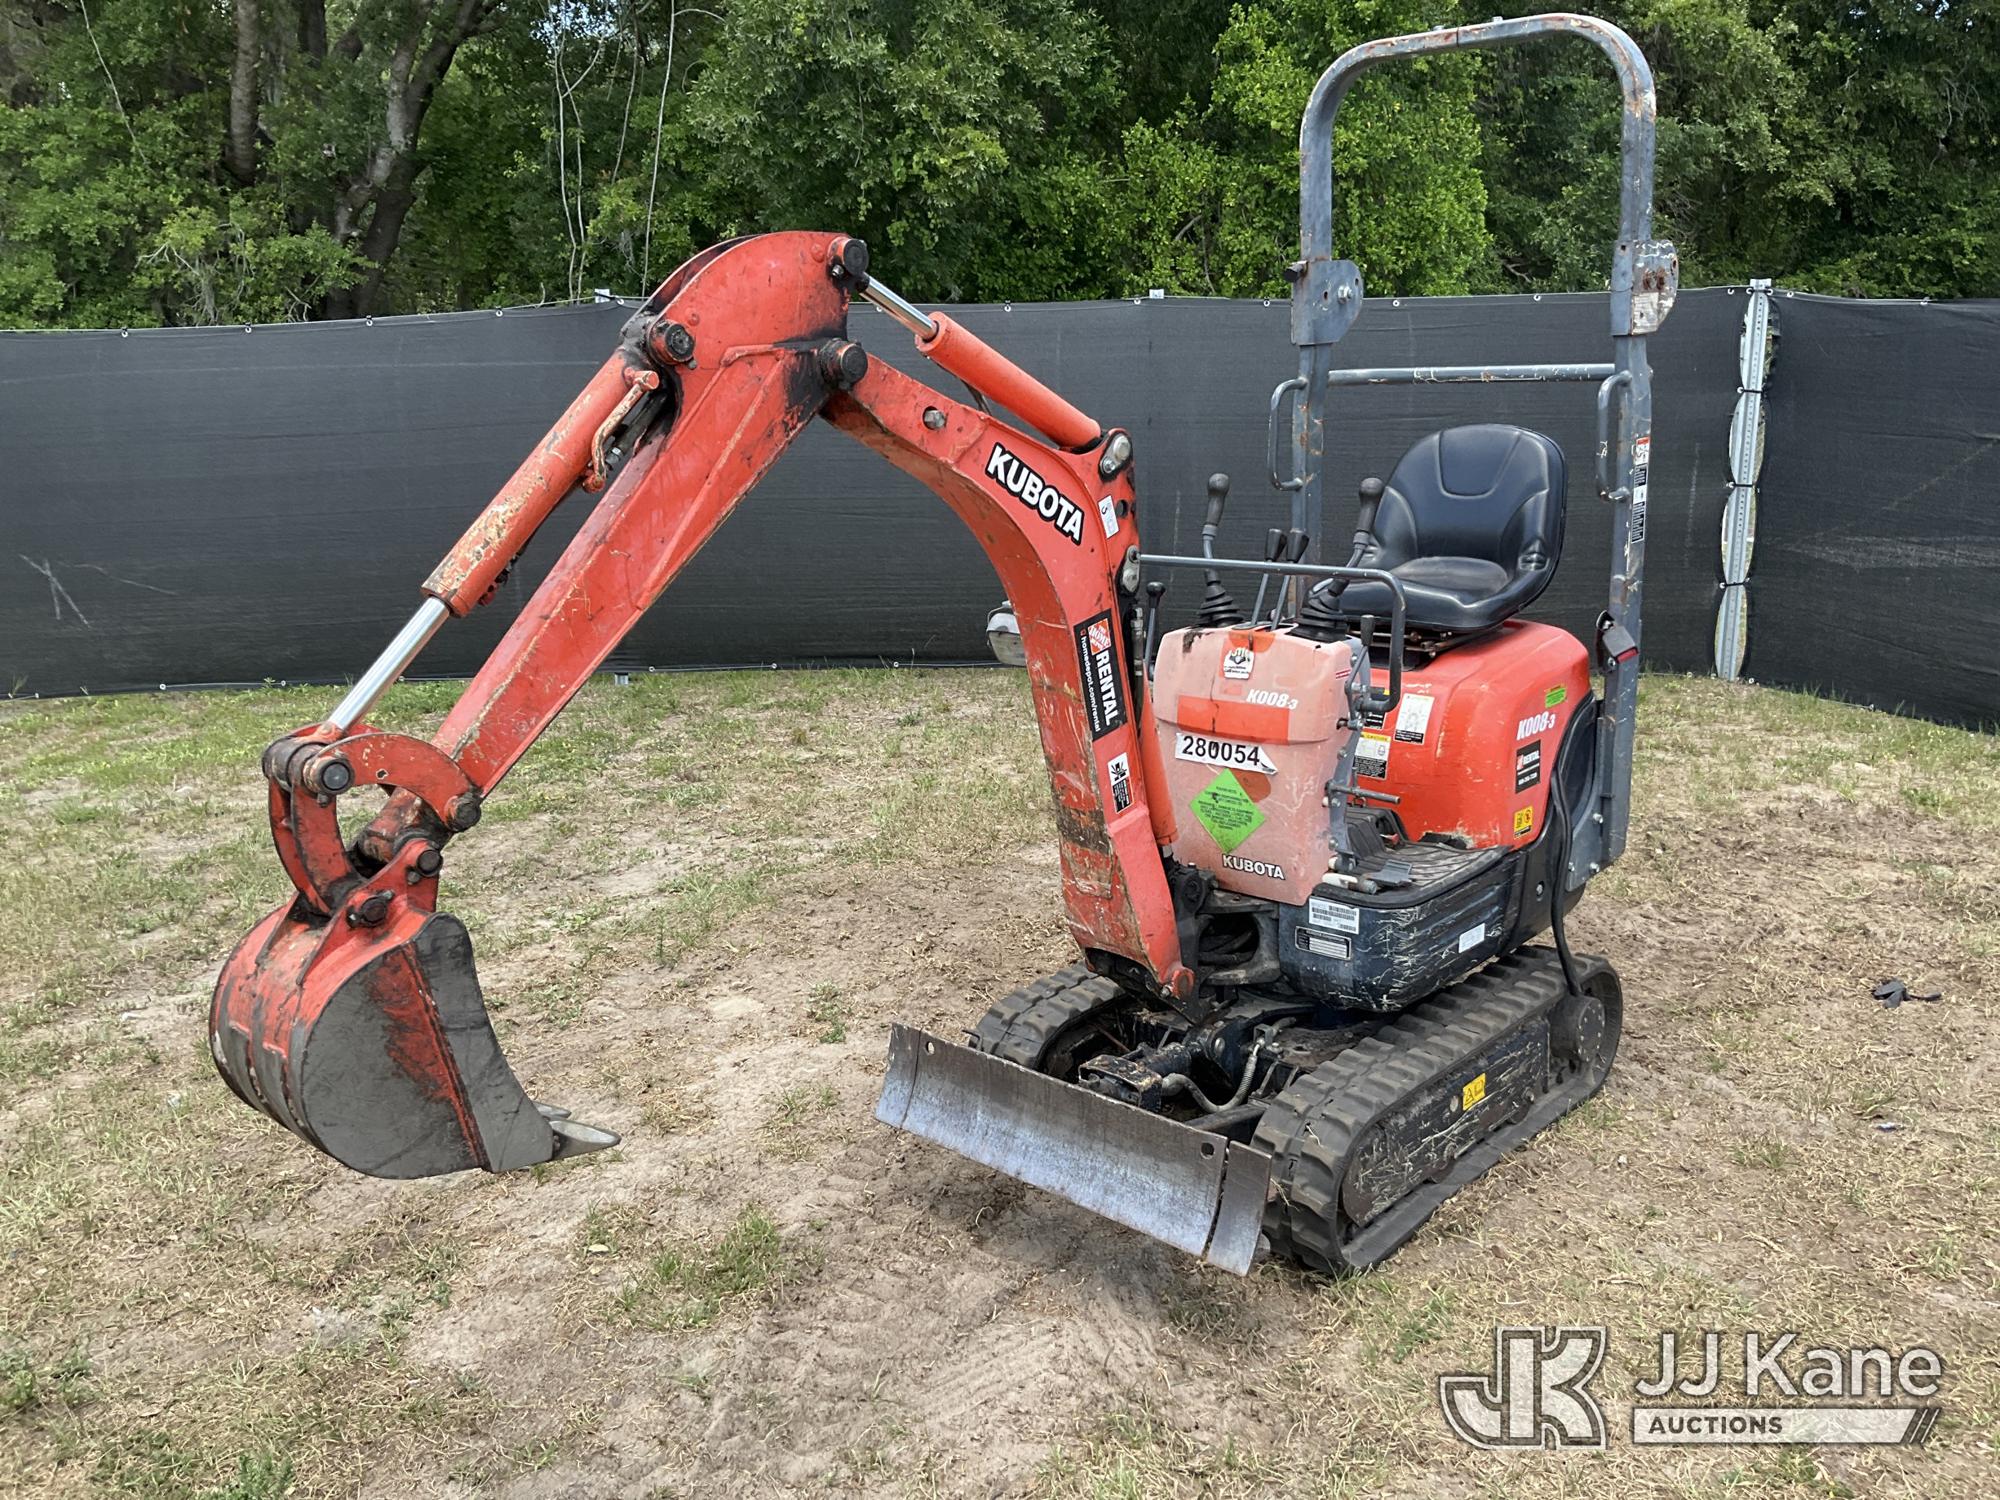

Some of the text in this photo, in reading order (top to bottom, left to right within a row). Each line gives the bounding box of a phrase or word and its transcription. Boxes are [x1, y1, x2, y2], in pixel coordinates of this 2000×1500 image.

[986, 443, 1083, 543] KUBOTA
[1080, 635, 1101, 732] homedepot.com/rental
[1096, 650, 1119, 726] RENTAL
[1246, 689, 1298, 710] K008-3
[1516, 711, 1556, 741] K008-3
[1182, 735, 1260, 766] 280054
[1222, 854, 1286, 880] KUBOTA
